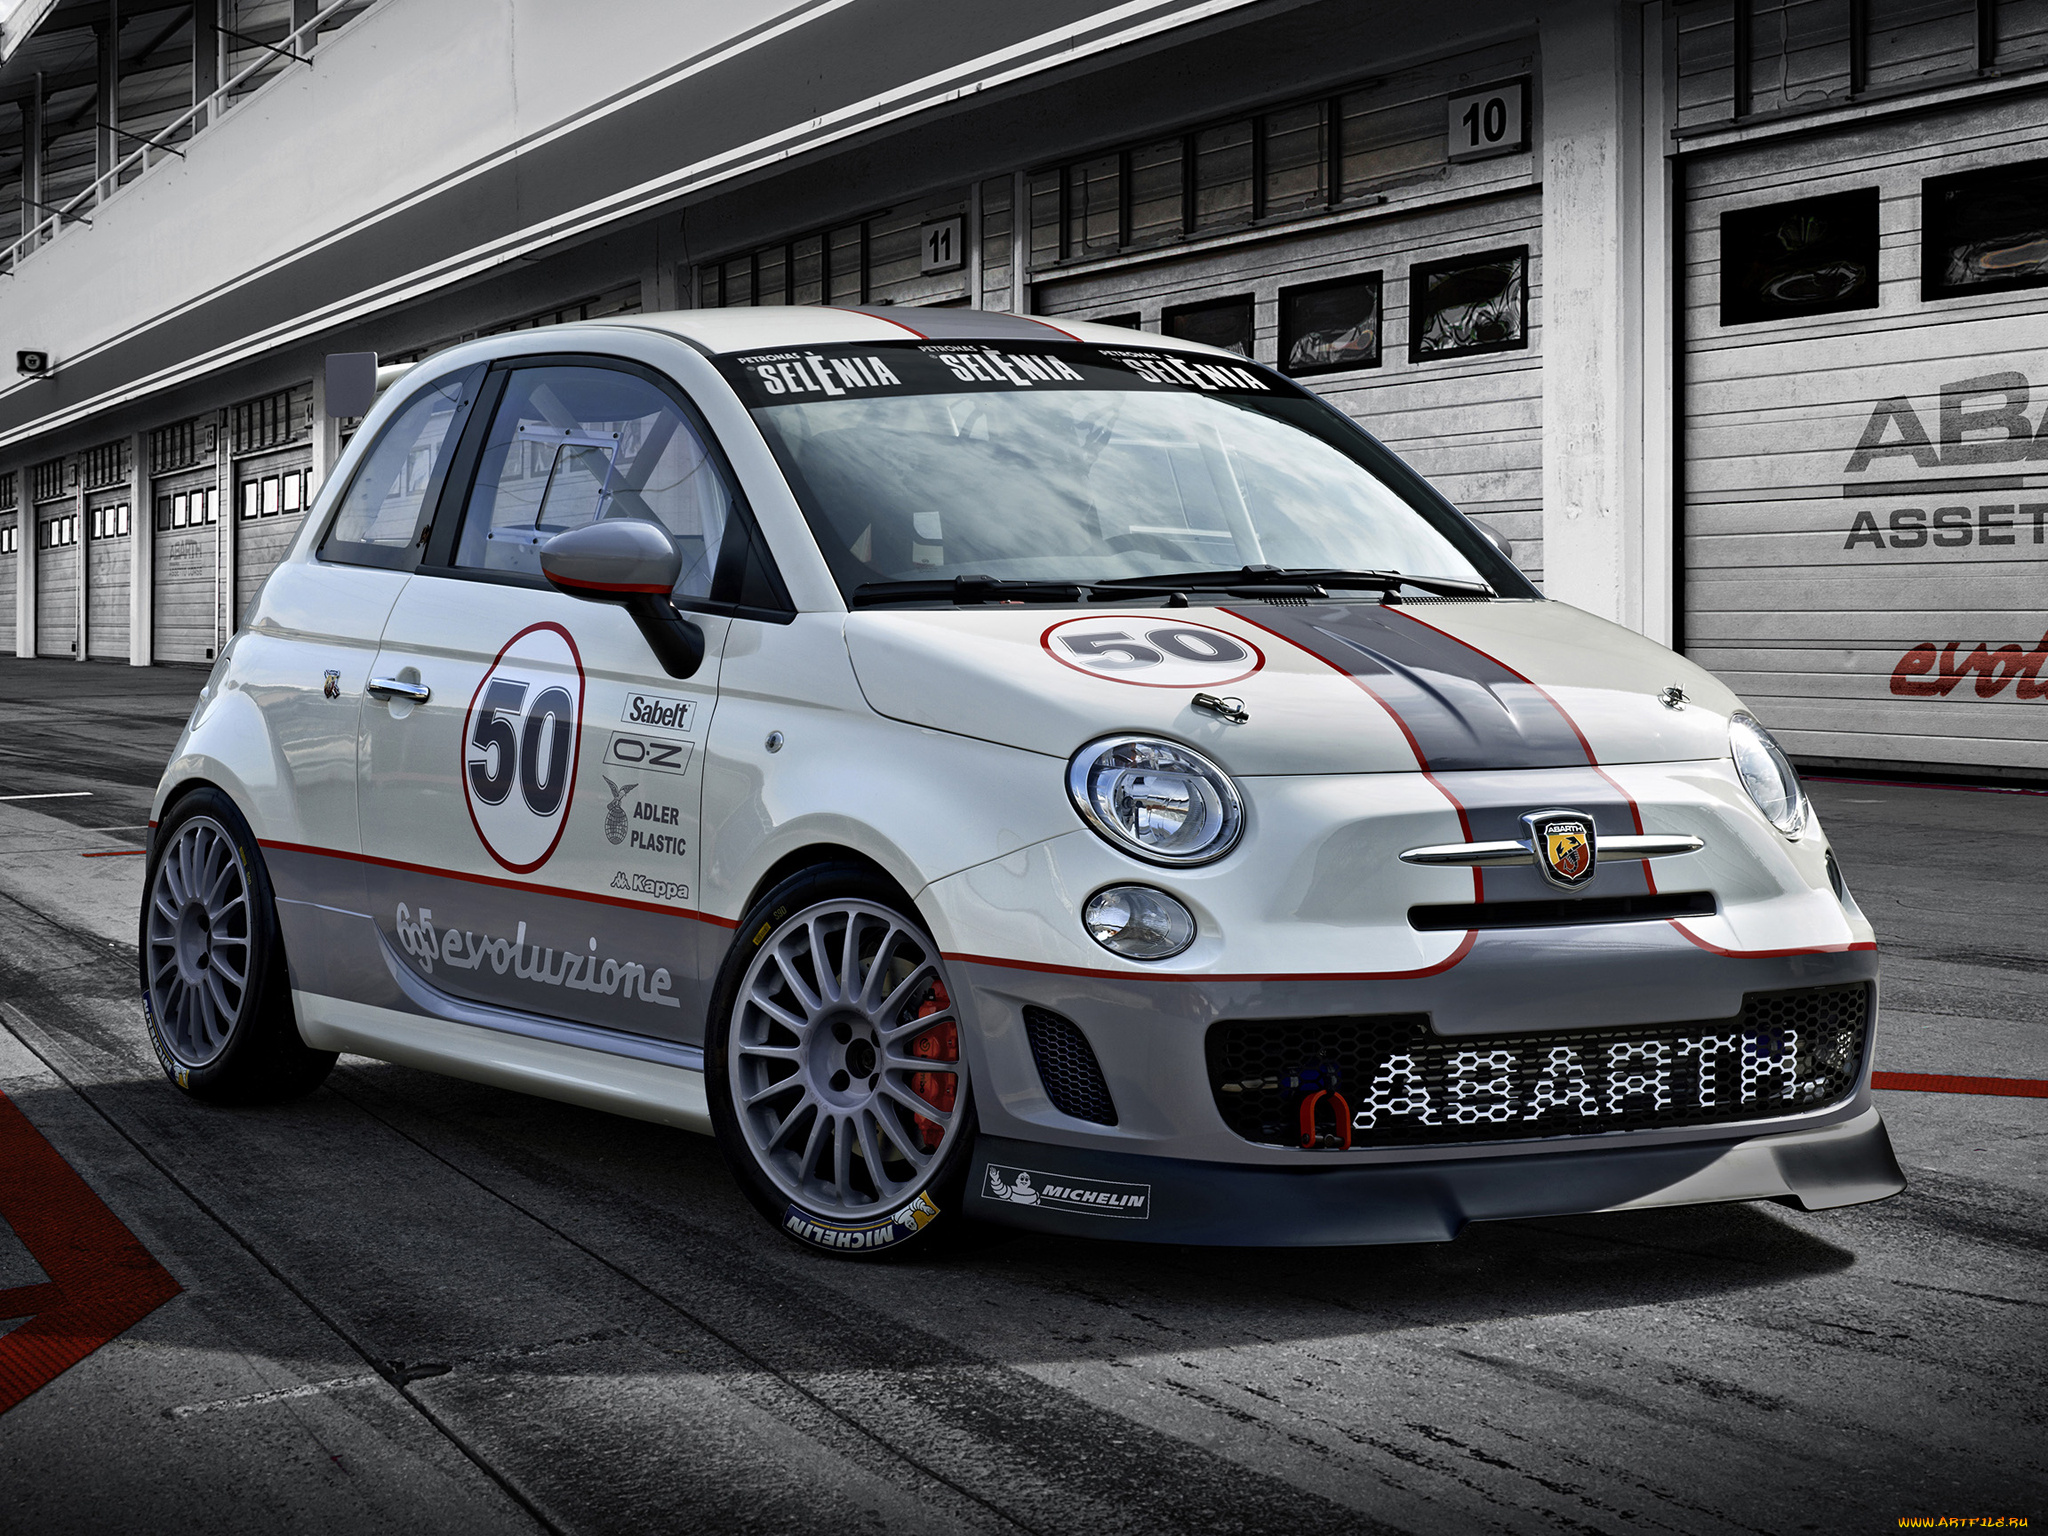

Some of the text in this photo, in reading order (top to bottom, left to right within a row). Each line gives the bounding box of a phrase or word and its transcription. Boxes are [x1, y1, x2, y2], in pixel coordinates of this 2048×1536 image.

[1463, 97, 1507, 146] 10
[929, 227, 950, 263] 11
[737, 352, 800, 364] PETRONAS
[1843, 370, 2048, 473] AB
[1057, 628, 1248, 671] 50
[629, 696, 688, 728] Sabelt
[468, 677, 575, 817] 50
[633, 801, 679, 826] ADLER
[630, 830, 686, 856] PLASTIC
[632, 874, 689, 899] Kappa
[441, 921, 681, 1008] evoluzione
[1352, 1030, 1797, 1129] ABARTH
[1041, 1184, 1145, 1208] MICHELIN
[786, 1215, 895, 1249] MICHELIN
